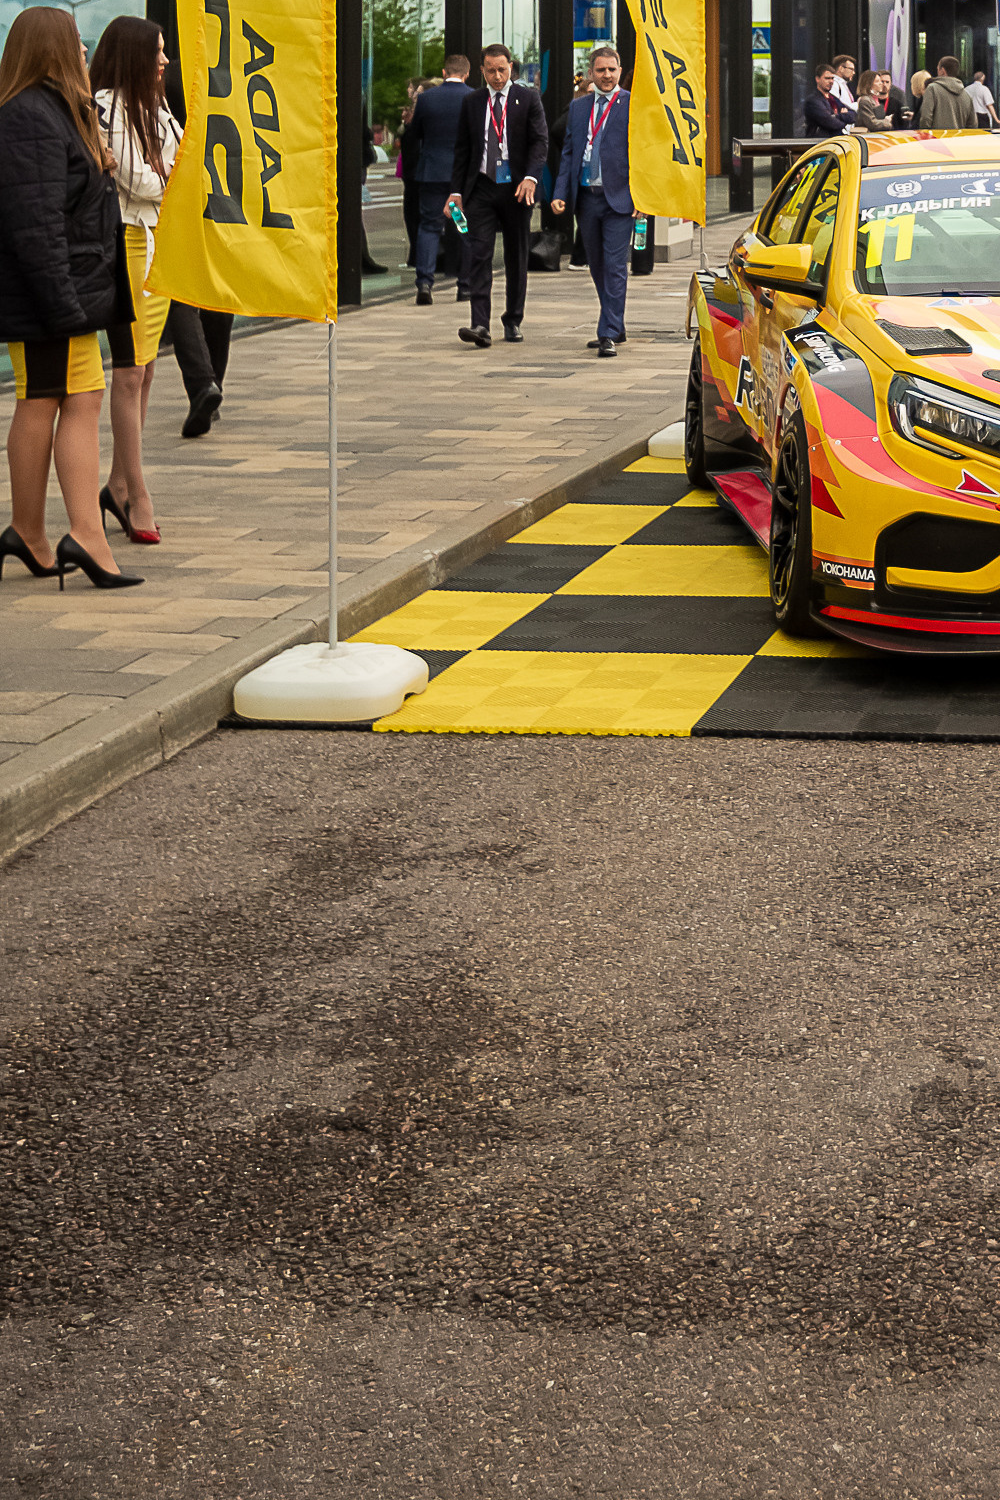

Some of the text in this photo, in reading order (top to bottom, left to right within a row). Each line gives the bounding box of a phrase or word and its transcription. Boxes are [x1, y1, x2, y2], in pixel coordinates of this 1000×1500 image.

[920, 171, 999, 181] Российская
[882, 196, 991, 217] ЛАДЫГИН
[857, 213, 916, 269] 11
[820, 560, 876, 581] YOKOHAMA
